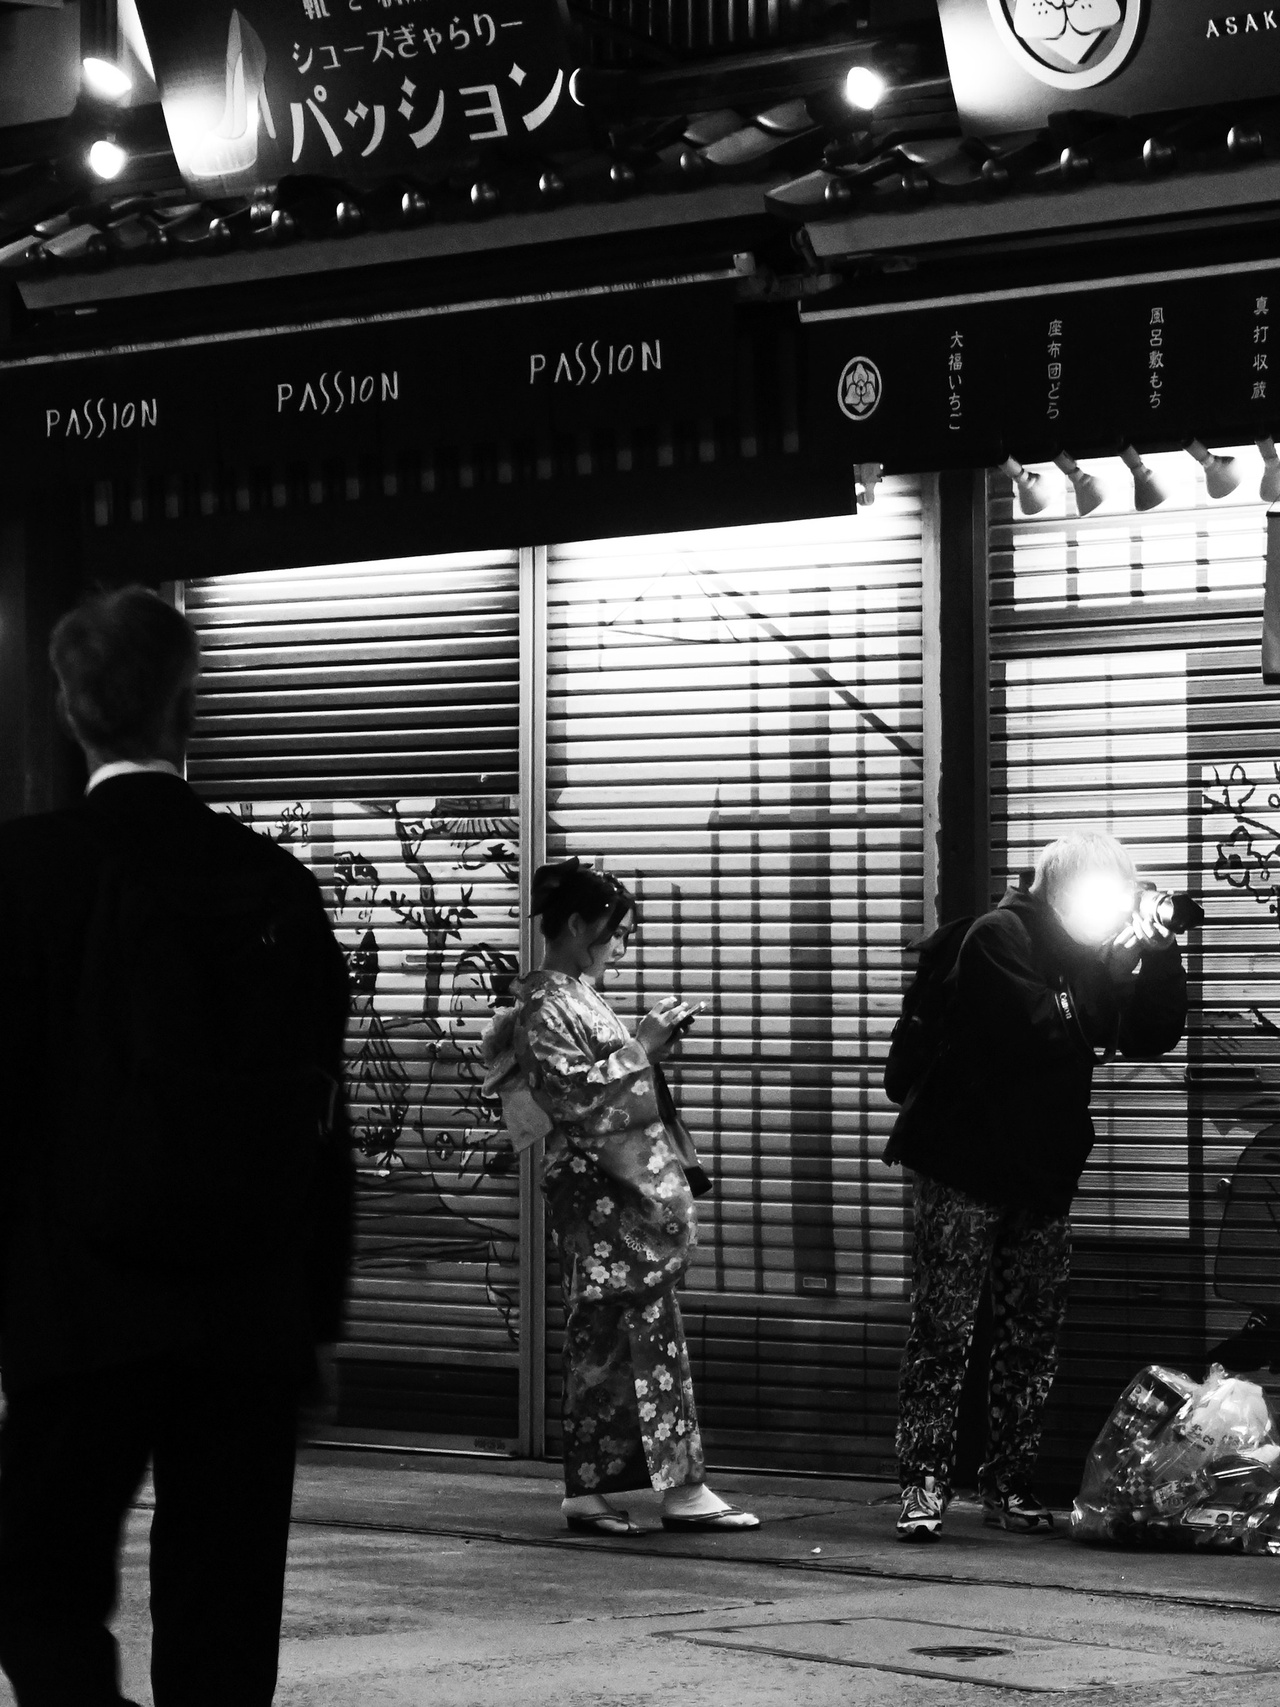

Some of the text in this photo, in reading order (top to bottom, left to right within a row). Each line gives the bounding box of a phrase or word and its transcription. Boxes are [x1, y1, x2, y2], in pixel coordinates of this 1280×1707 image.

[292, 13, 523, 74] シューズぎゃらりー
[290, 62, 564, 163] パッション
[277, 371, 399, 414] PASSION
[530, 340, 662, 385] PASSION
[948, 331, 964, 430] 大福いちご
[1047, 319, 1063, 419] 座布団どら
[1148, 307, 1165, 409] 風呂敷もち
[1250, 296, 1269, 399] 真打収蔵
[46, 398, 158, 439] PASSION
